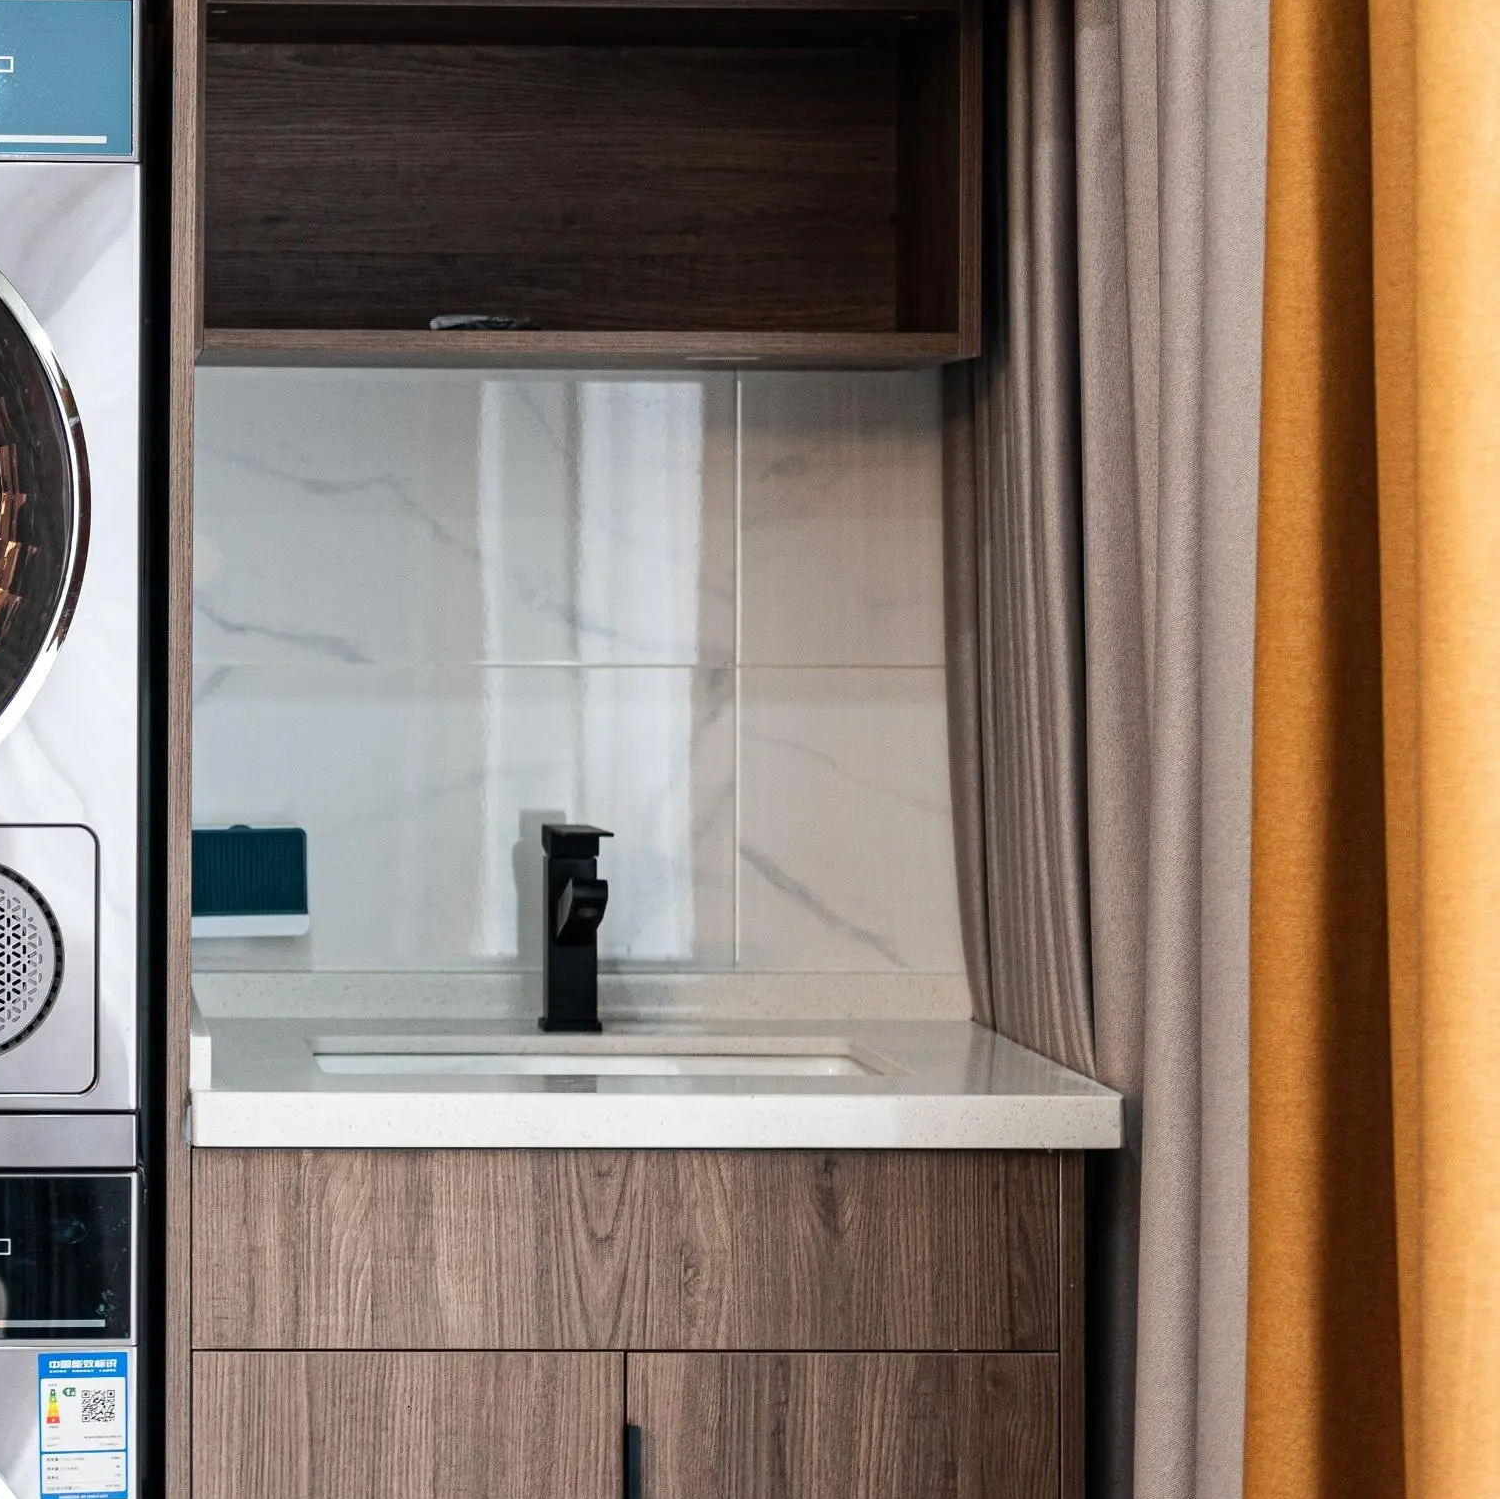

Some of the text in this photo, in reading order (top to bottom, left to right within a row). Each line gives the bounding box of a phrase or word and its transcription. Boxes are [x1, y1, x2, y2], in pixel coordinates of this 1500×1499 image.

[49, 1358, 117, 1369] 中国能效标识
